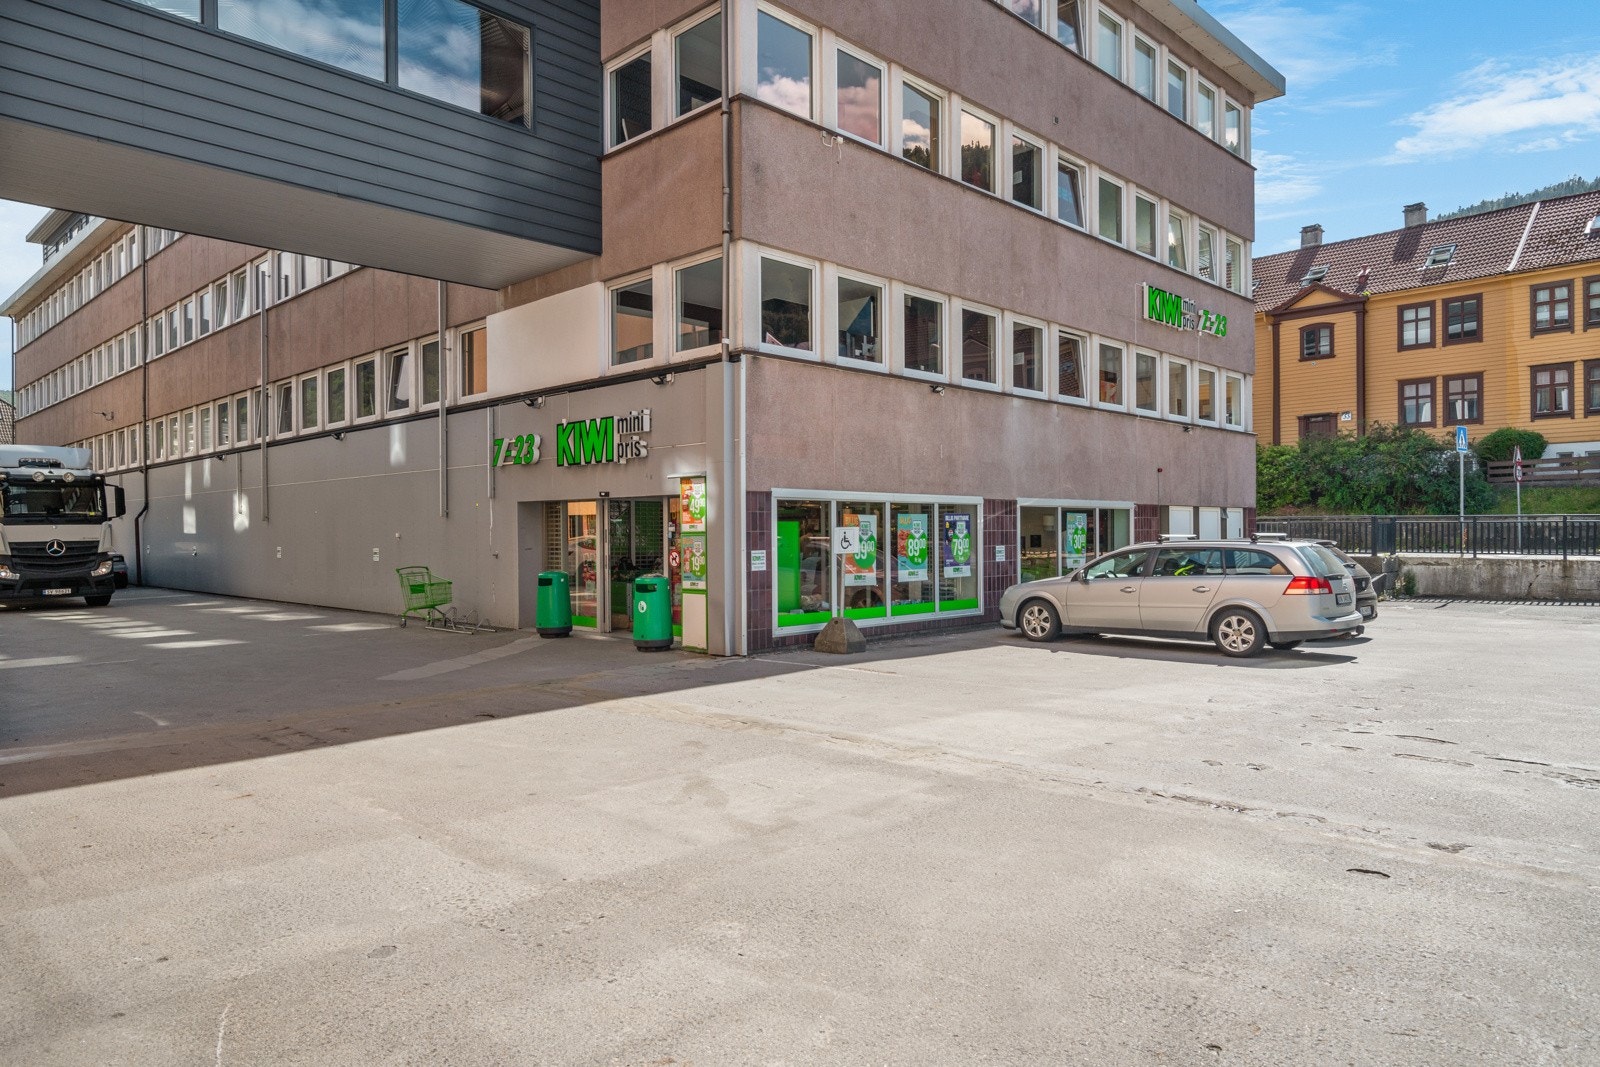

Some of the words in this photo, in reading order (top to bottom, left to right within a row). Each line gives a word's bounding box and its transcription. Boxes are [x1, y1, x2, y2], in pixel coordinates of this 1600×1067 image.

[1148, 285, 1182, 328] KIWI
[1183, 299, 1196, 313] mini
[1183, 315, 1195, 330] pris
[1201, 309, 1227, 337] 7-23
[492, 434, 536, 467] 7-23
[556, 416, 614, 467] KIWI
[617, 409, 645, 434] mini
[617, 436, 642, 460] pris
